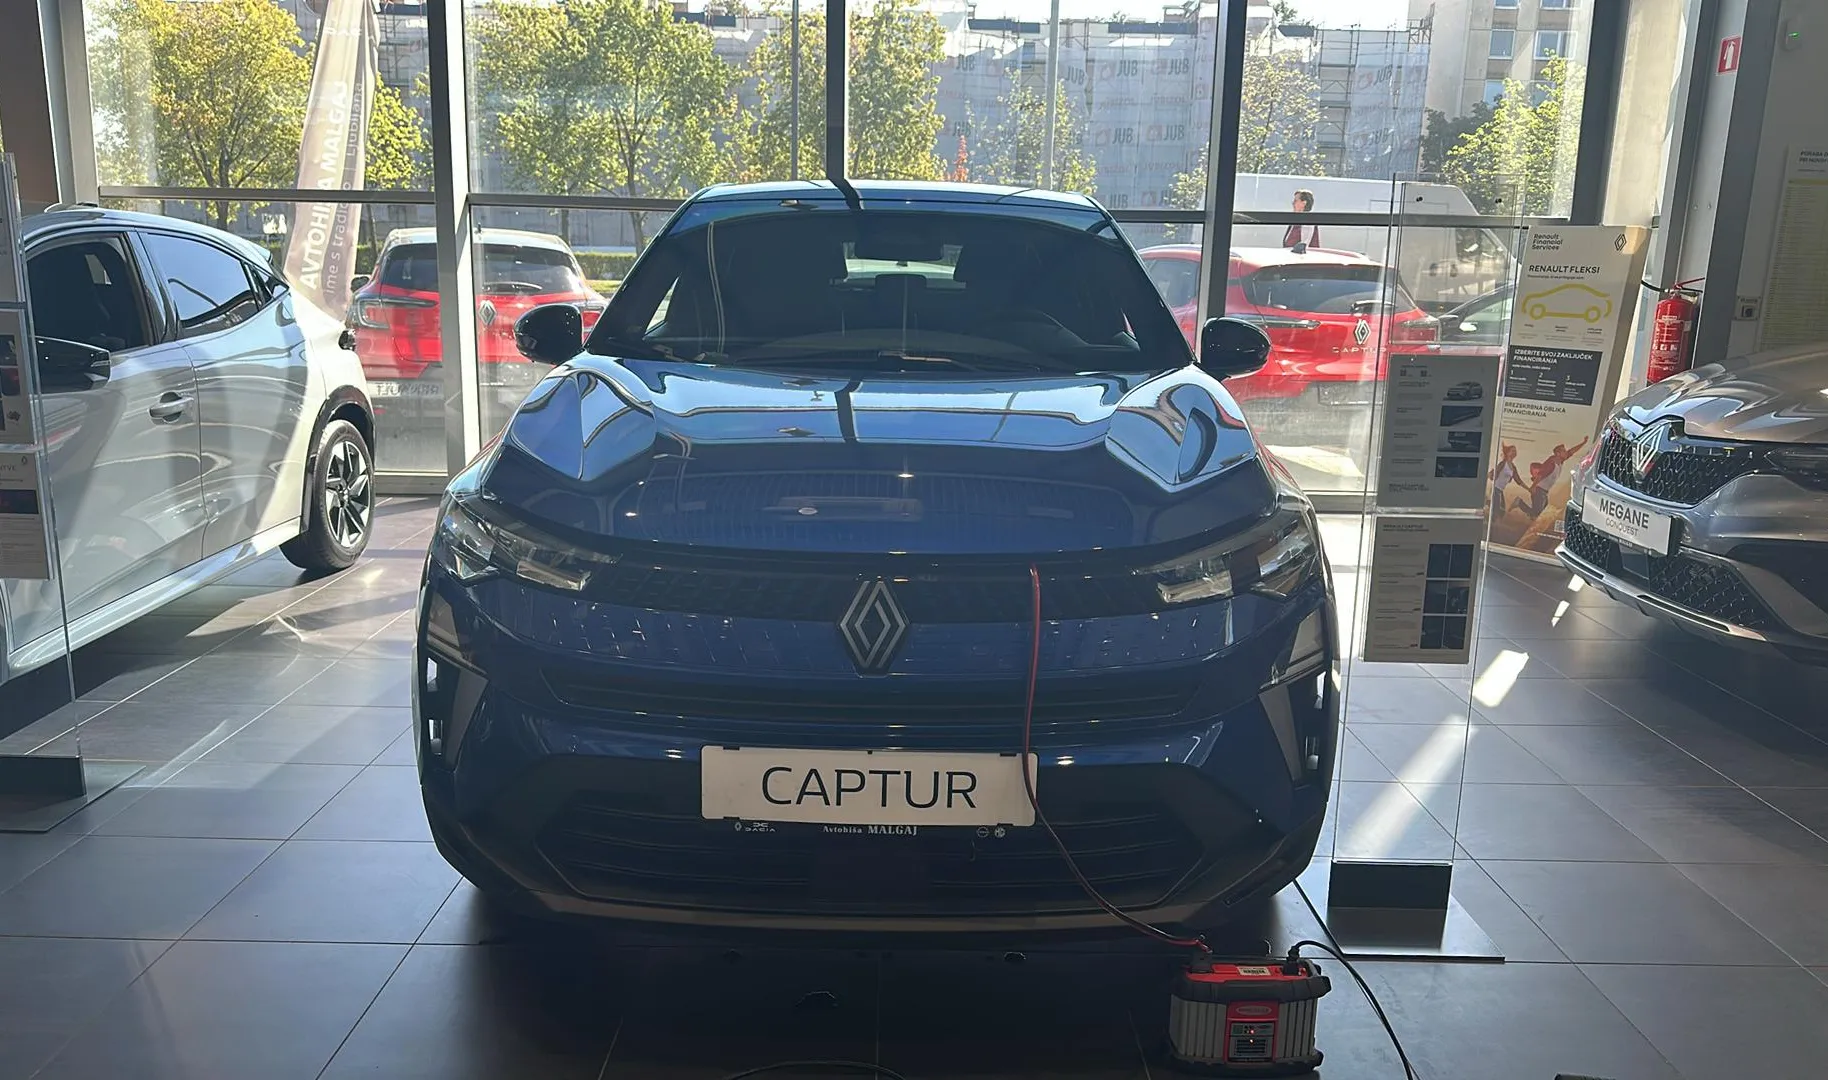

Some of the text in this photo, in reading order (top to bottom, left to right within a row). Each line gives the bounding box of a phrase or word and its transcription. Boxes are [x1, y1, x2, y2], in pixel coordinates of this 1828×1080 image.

[1065, 65, 1085, 85] JUB
[1116, 60, 1139, 77] JUB
[1168, 59, 1189, 75] JUB
[320, 80, 348, 174] MALGAJ
[1164, 125, 1185, 141] JUB
[1112, 128, 1133, 144] JUB
[299, 177, 337, 290] AVTOHIA
[1528, 264, 1601, 274] RENAULT FLEKSI
[1513, 355, 1558, 364] FINANCIRANJA
[1514, 348, 1541, 357] IZBERITE
[1540, 350, 1556, 358] SVOJ
[1503, 407, 1547, 418] FINANCIRANJA
[1599, 498, 1650, 529] MEGANE
[1605, 517, 1639, 536] CONQUEST
[761, 766, 978, 809] CAPTUR
[867, 825, 918, 836] MALGAJ
